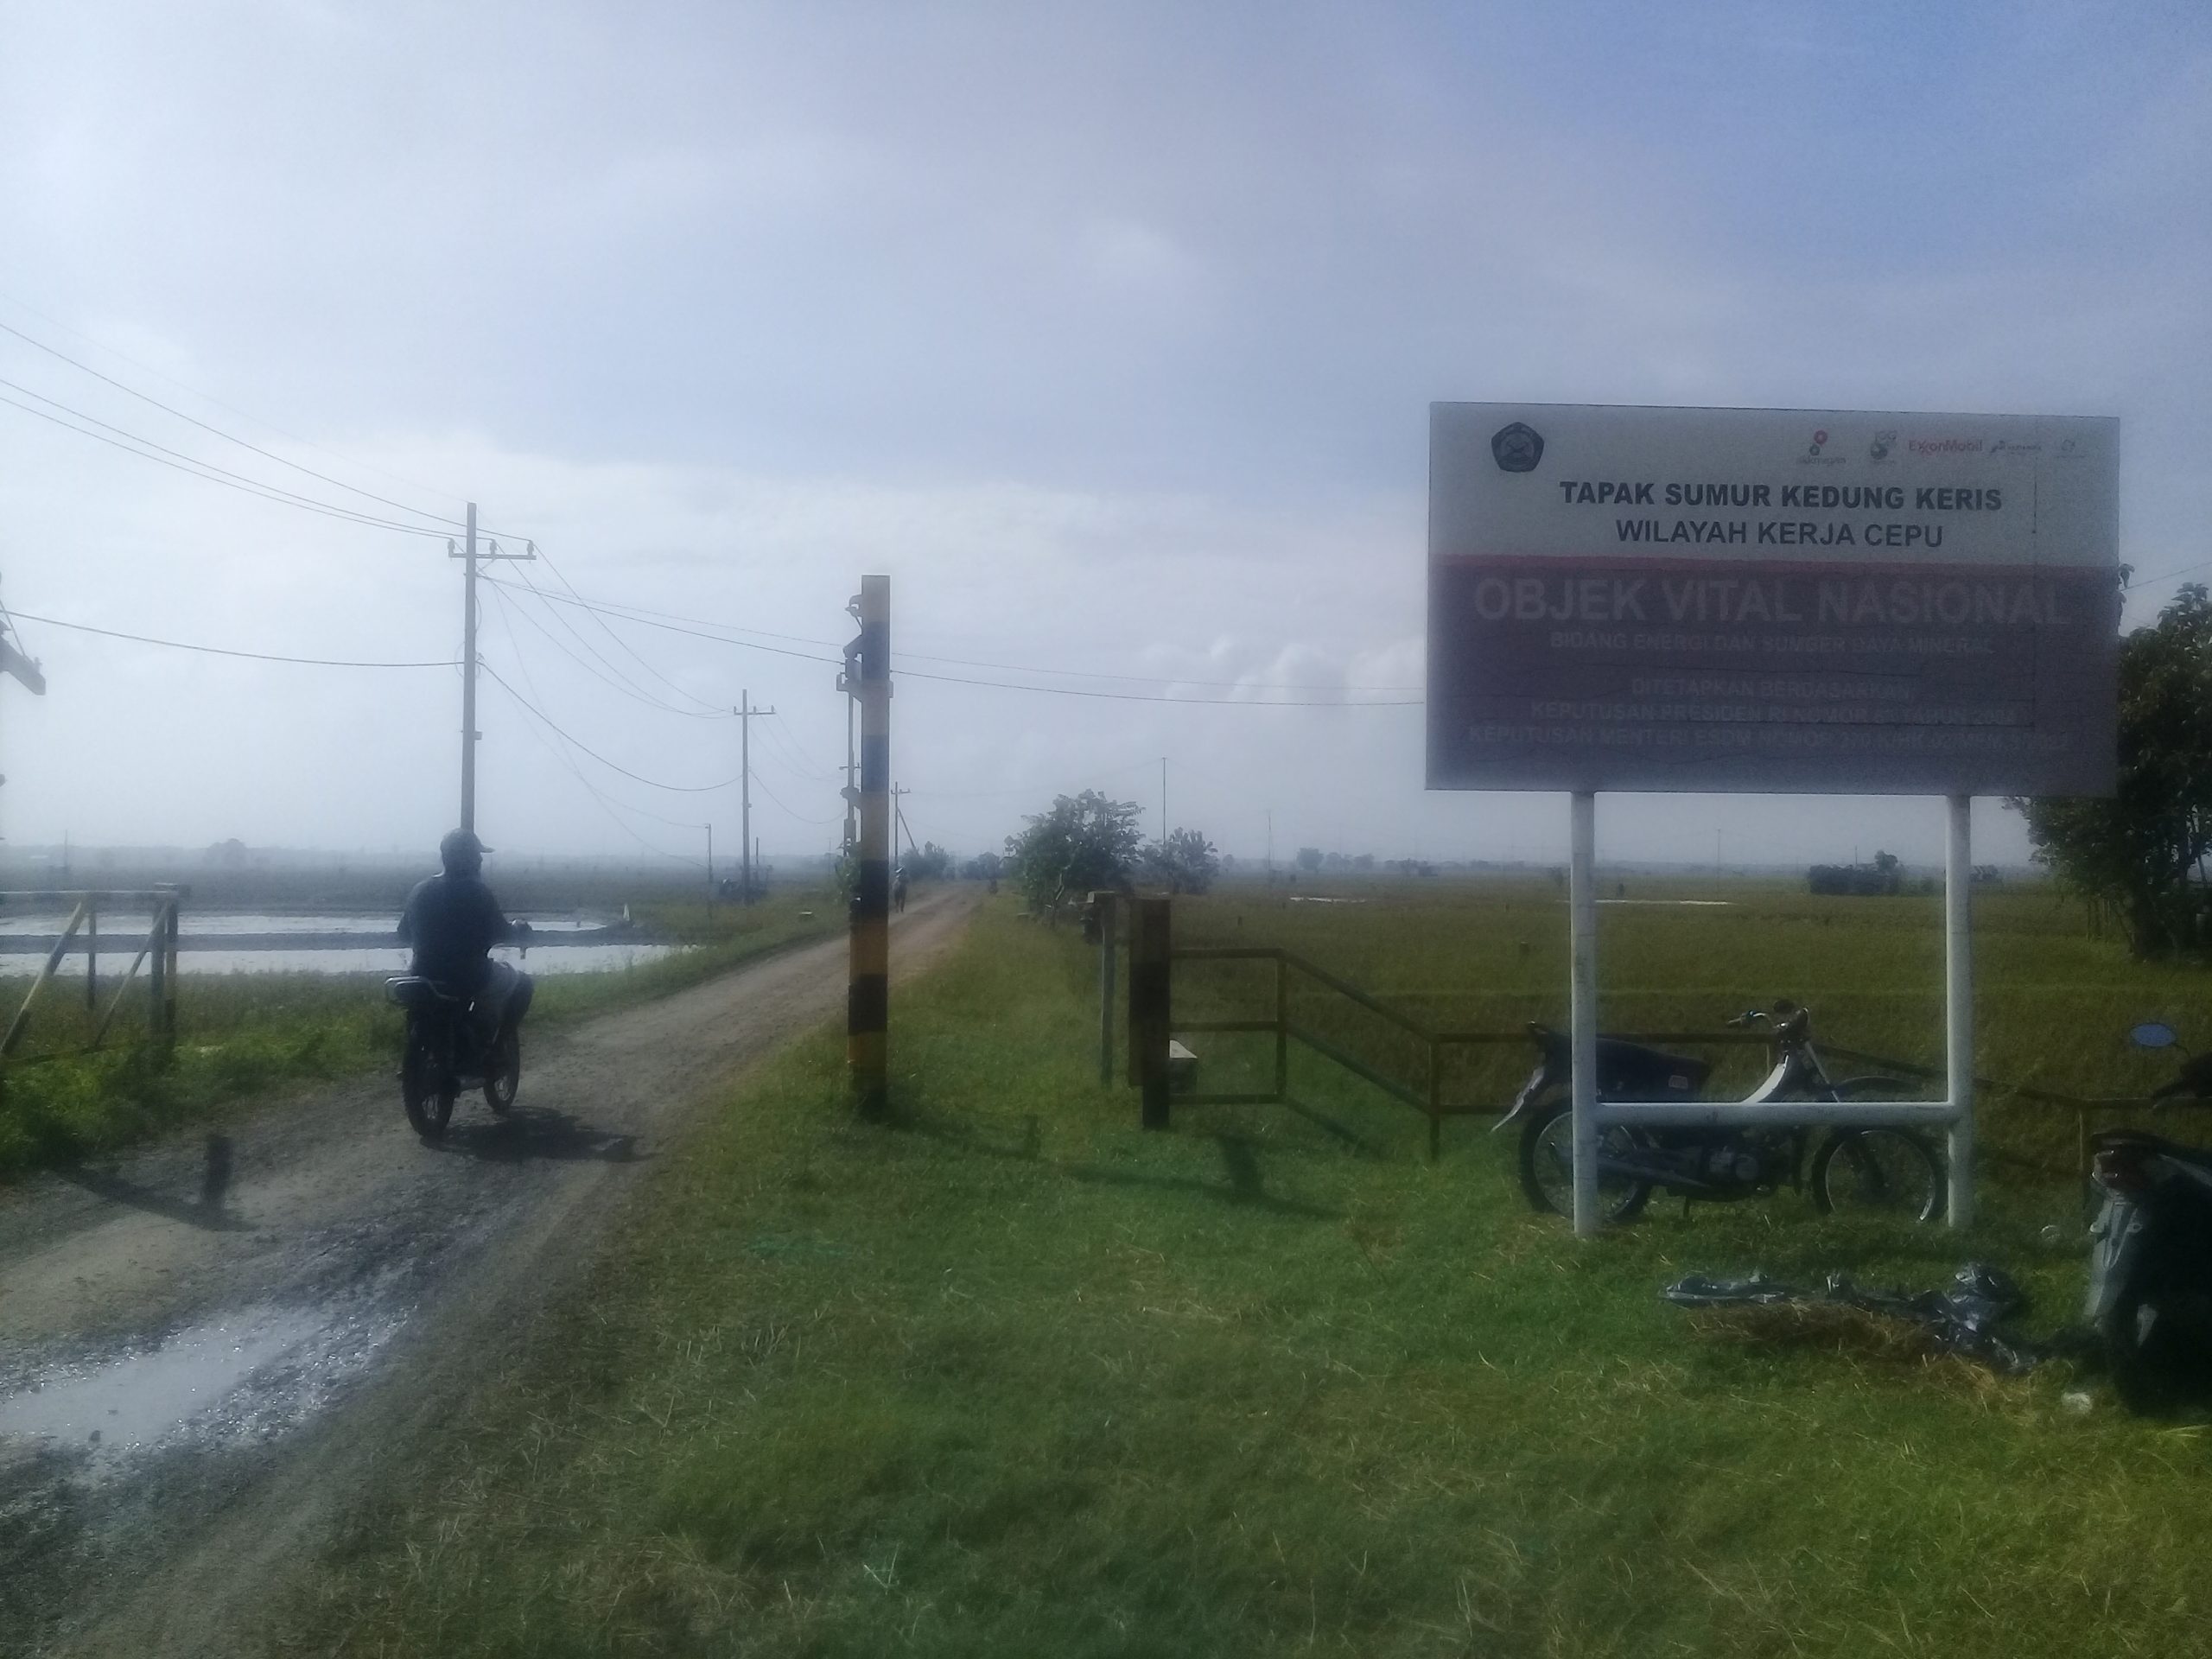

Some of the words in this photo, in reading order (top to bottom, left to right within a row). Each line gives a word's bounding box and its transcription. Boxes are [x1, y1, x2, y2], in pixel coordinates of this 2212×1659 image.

[1909, 439, 1983, 454] ExxonMobil
[1559, 480, 1655, 505] TAPAK
[1665, 483, 1771, 506] SUMUR
[1782, 485, 1904, 509] KEDUNG
[1916, 487, 2002, 511] KERIS
[1616, 519, 1746, 543] WILAYAH
[1758, 522, 1855, 545] KERJA
[1864, 524, 1943, 548] CEPU
[1474, 577, 1647, 620] OBJEK
[1662, 579, 1802, 621] VITAL
[1818, 581, 2071, 625] NASIONAL
[1550, 632, 1627, 648] BIDANG
[1633, 633, 1708, 650] ENERGI
[1714, 635, 1755, 651] DAN
[1761, 636, 1846, 652] SUMBER
[1631, 677, 1755, 696] DITETAPKAN
[1530, 702, 1655, 720] KEPUTUSAN
[1662, 704, 1760, 721] PRESIDEN
